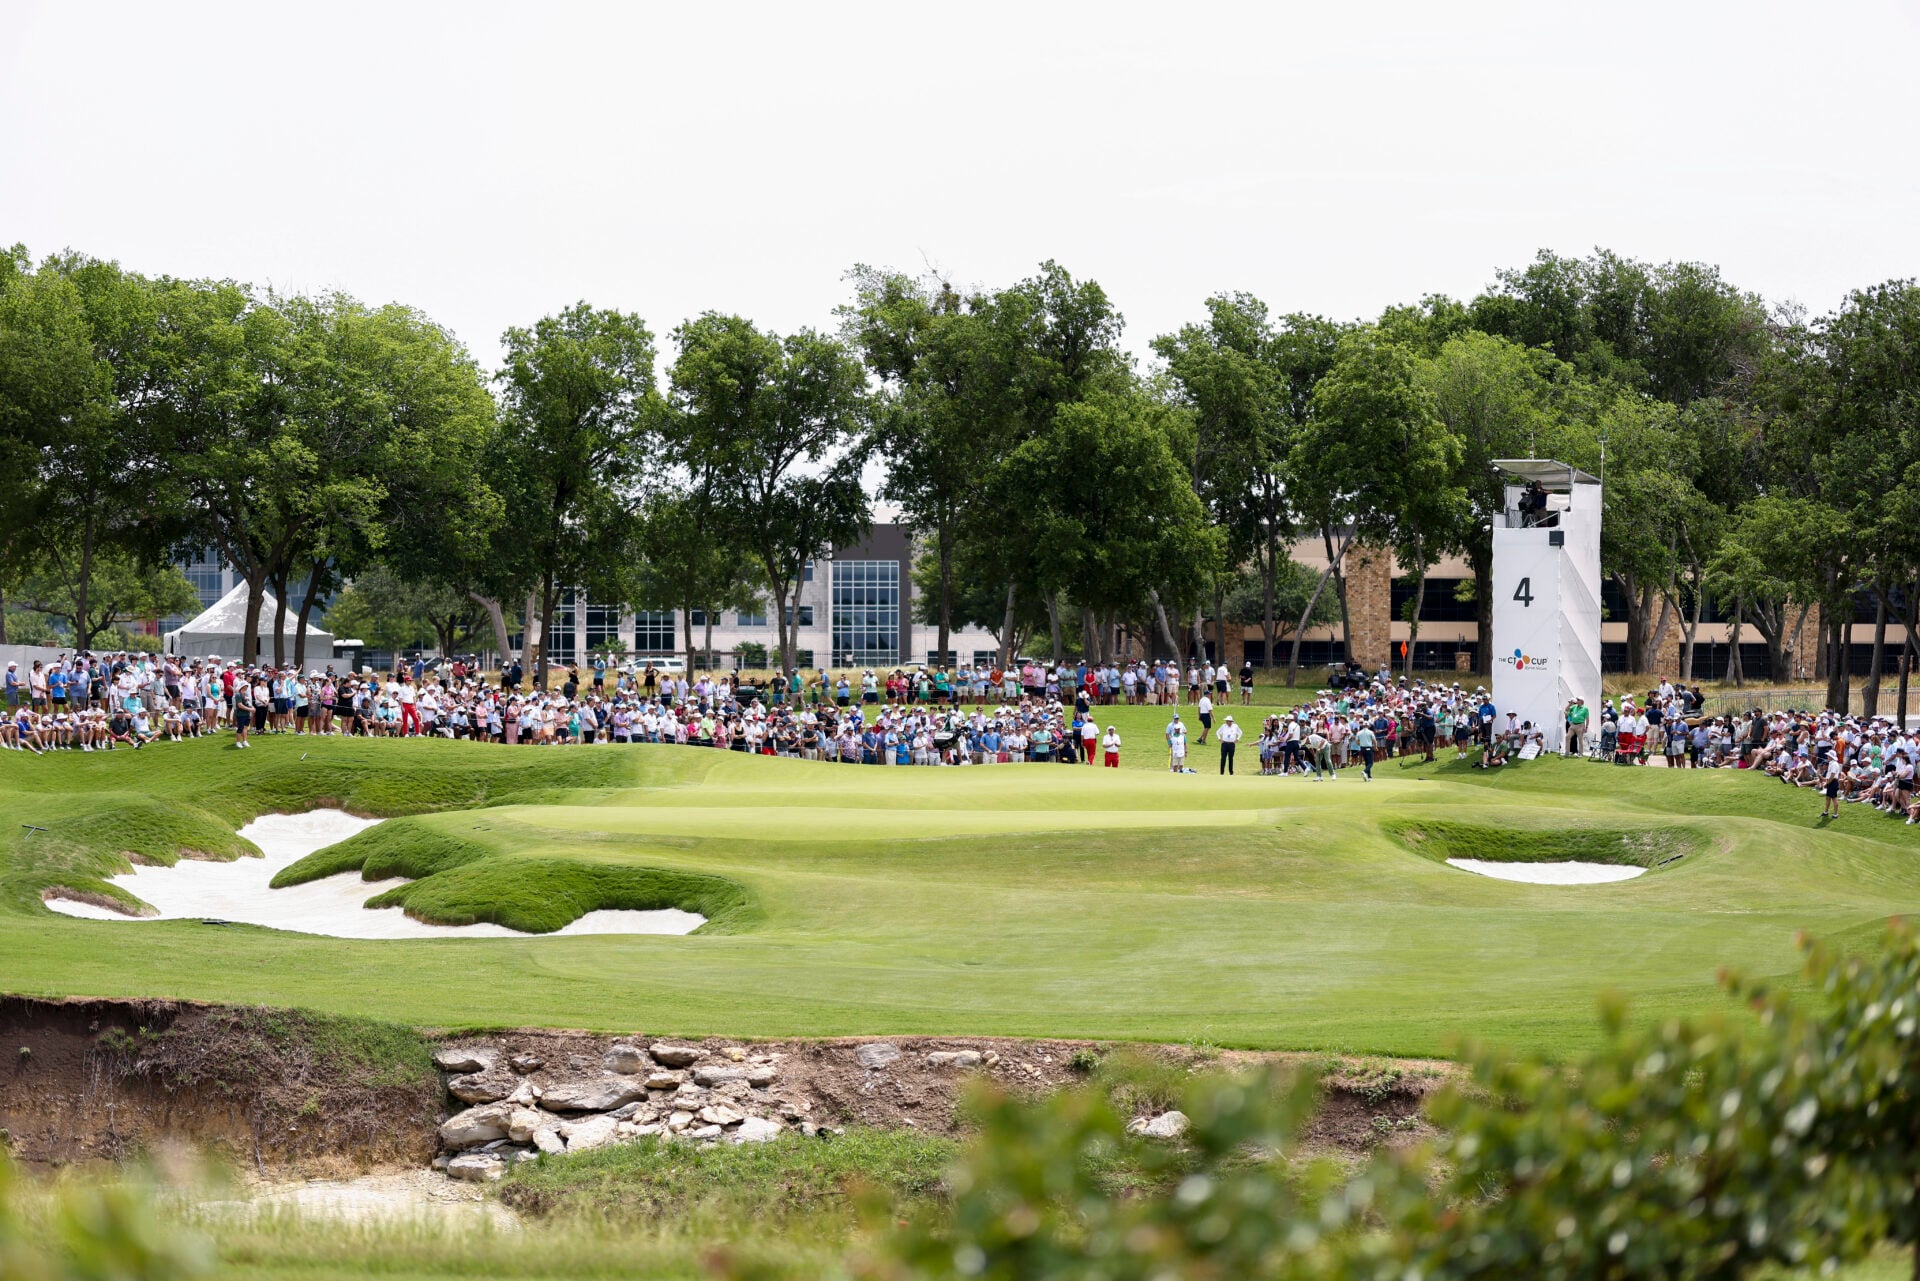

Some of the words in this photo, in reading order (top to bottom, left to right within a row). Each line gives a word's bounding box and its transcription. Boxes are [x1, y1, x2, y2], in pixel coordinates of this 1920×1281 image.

[1513, 577, 1534, 608] 4
[1507, 656, 1516, 665] CJ
[1531, 657, 1547, 665] CUP
